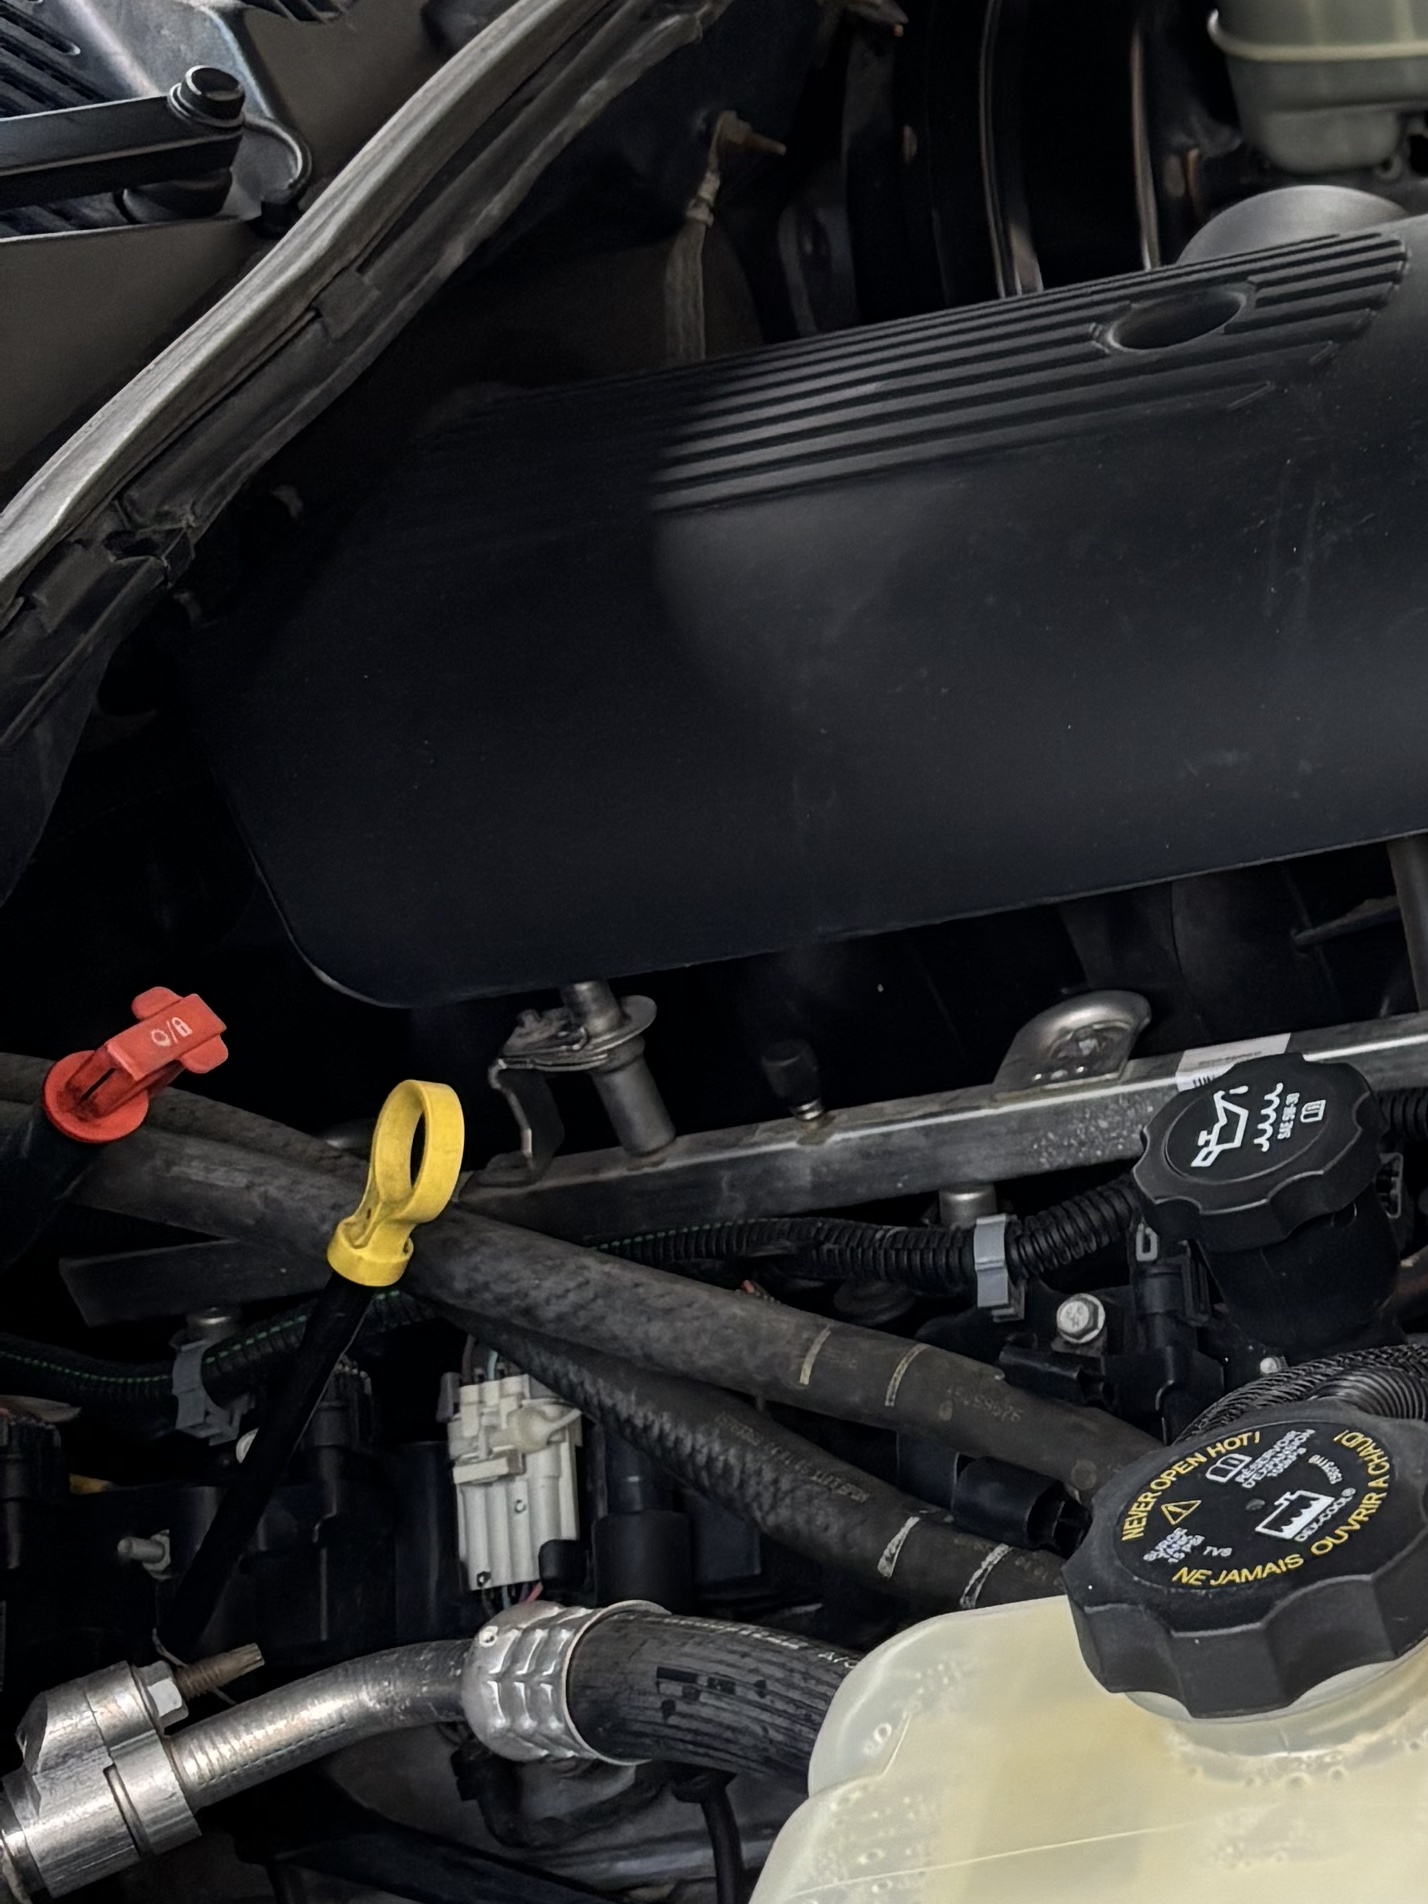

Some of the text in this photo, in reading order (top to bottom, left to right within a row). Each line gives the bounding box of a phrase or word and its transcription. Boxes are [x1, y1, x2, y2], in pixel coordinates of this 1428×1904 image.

[1122, 1491, 1162, 1540] NEVER
[1150, 1452, 1207, 1490] OPEN
[1172, 1567, 1212, 1585] NE
[1210, 1554, 1304, 1586] JAMAIS
[1311, 1492, 1387, 1555] OUVRIR
